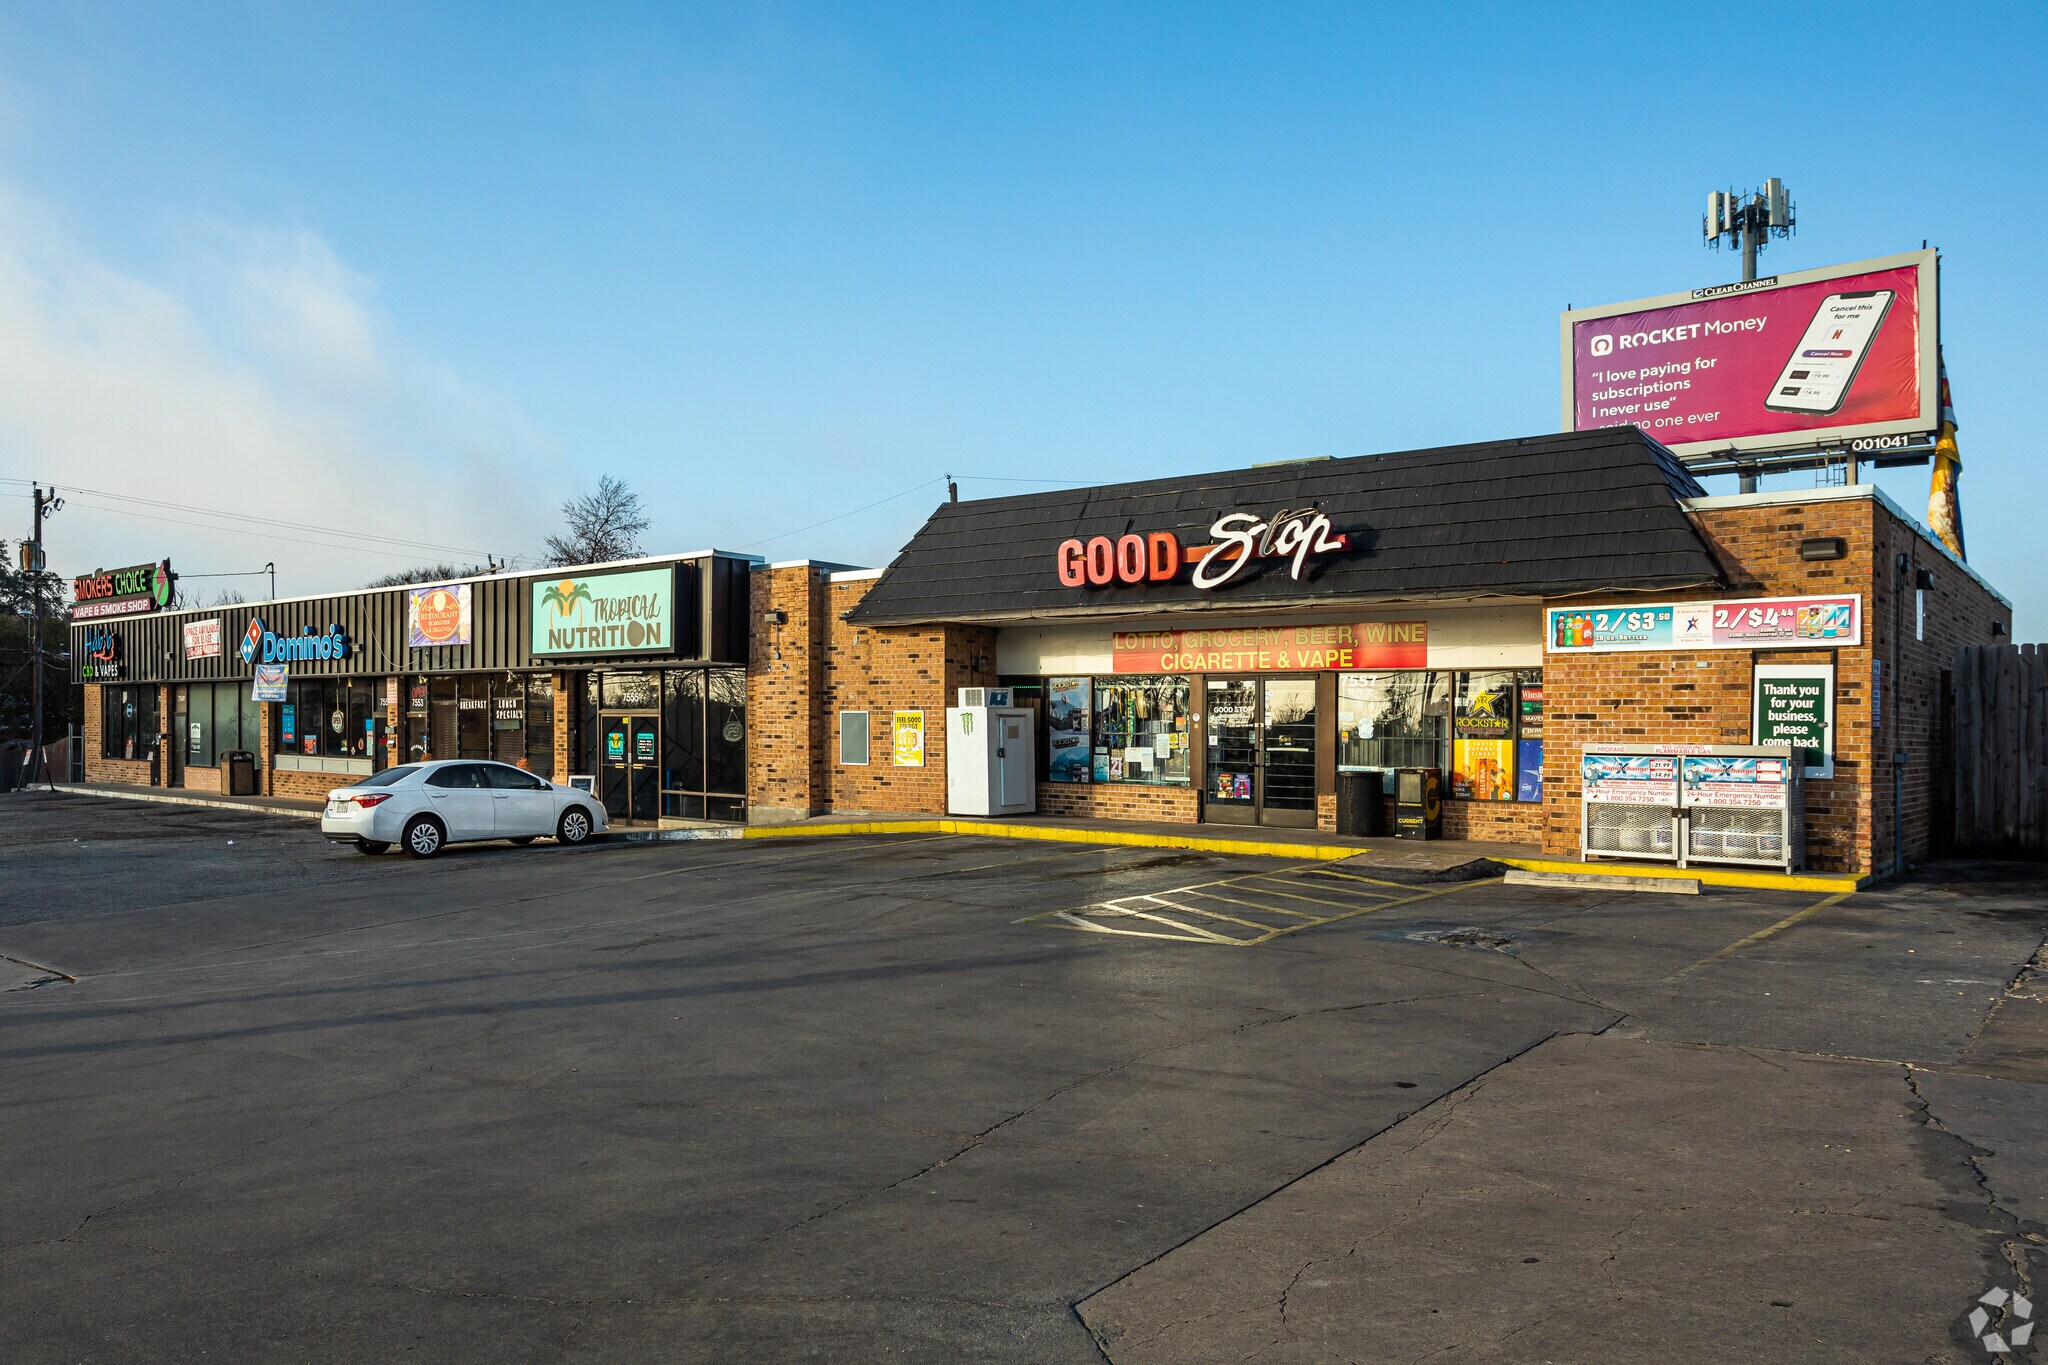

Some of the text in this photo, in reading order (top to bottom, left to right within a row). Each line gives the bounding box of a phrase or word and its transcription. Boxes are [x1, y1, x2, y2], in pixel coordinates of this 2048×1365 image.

[1858, 303, 1873, 311] this
[1619, 316, 1767, 350] ROCKET Money
[1606, 367, 1637, 382] love
[1640, 361, 1691, 381] paying
[1694, 357, 1718, 371] for
[1592, 379, 1691, 401] subscriptions
[1592, 406, 1597, 418] I
[1600, 403, 1641, 418] never
[1655, 416, 1684, 428] one
[1687, 410, 1721, 424] ever
[1852, 435, 1908, 451] 001041
[1057, 507, 1344, 589] GOOD Stop
[73, 569, 147, 601] SMOKERS CHOICE
[75, 599, 148, 619] VAPE & SMOKE SHOP
[420, 611, 458, 620] RESTAURANT
[592, 592, 661, 624] TROPICAL
[548, 620, 661, 650] NUTRITION
[1114, 623, 1426, 652] LOTTO, GROCERY, BEER, WINE
[263, 623, 344, 663] Domino's
[1160, 648, 1353, 671] CIGARETTE & VAPE
[82, 664, 118, 678] CBD & VAPES
[1340, 675, 1378, 687] 7557
[622, 692, 639, 702] 7555
[989, 689, 1009, 706] ICE
[1763, 683, 1820, 698] Thank you
[411, 698, 424, 707] 7553
[459, 700, 487, 710] BREAKFAST
[498, 699, 517, 709] LUNCH
[1770, 696, 1815, 711] for your
[896, 716, 922, 724] FEEL GOOD
[1768, 710, 1818, 724] business,
[1773, 722, 1809, 737] please
[1762, 736, 1820, 748] come back
[1586, 788, 1675, 797] 24-Hour Emergency Number:
[1606, 795, 1655, 803] 1.800.354.7250
[1714, 792, 1753, 801] Emergency
[1708, 798, 1762, 806] 1.800.354.7250
